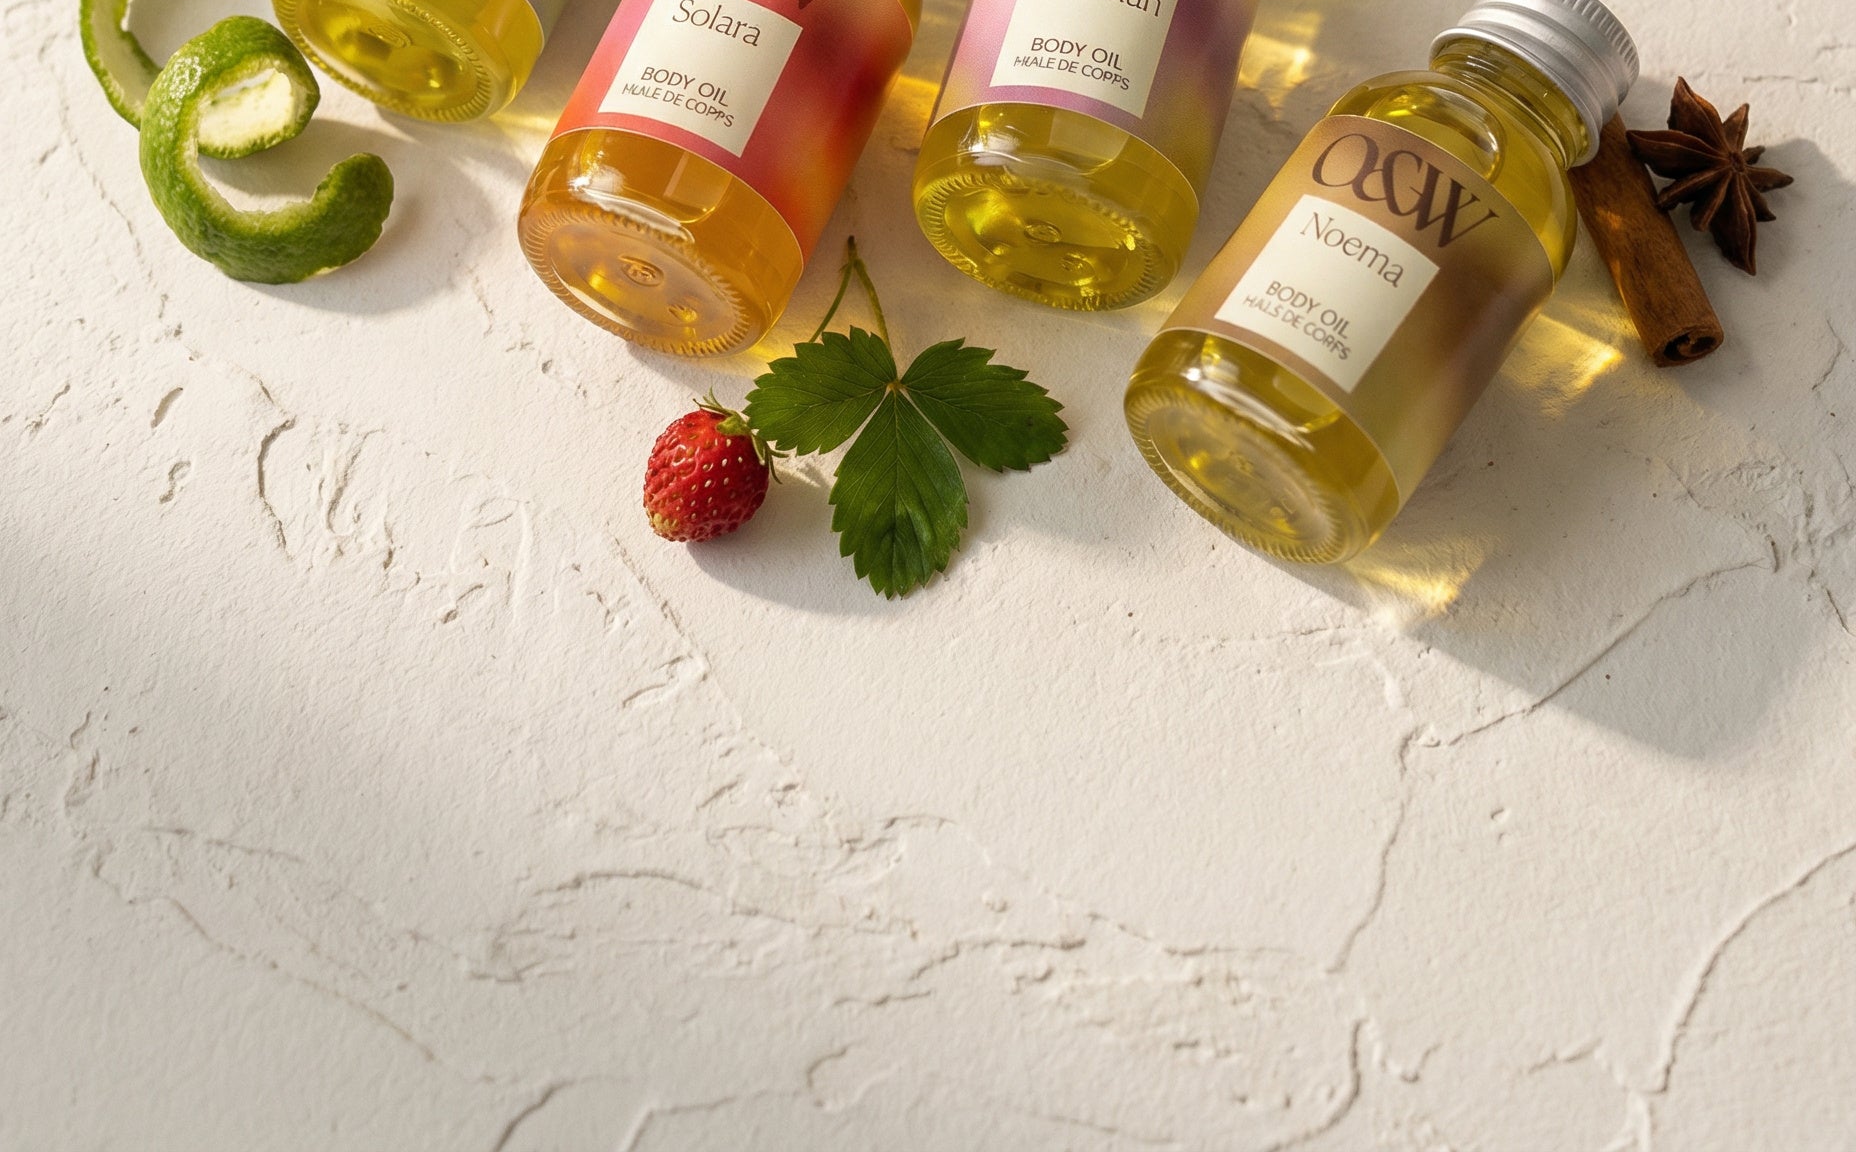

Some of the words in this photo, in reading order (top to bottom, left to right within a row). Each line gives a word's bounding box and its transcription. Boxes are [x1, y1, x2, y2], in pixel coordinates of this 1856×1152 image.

[1031, 38, 1087, 57] BODY
[1091, 48, 1123, 71] OIL
[1057, 59, 1080, 73] DE
[640, 66, 696, 90] BODY
[698, 82, 728, 107] OIL
[662, 90, 685, 106] DE
[1300, 211, 1404, 288] Noema
[1265, 280, 1321, 314] BODY
[1320, 309, 1350, 339] OIL
[1281, 309, 1305, 329] DE
